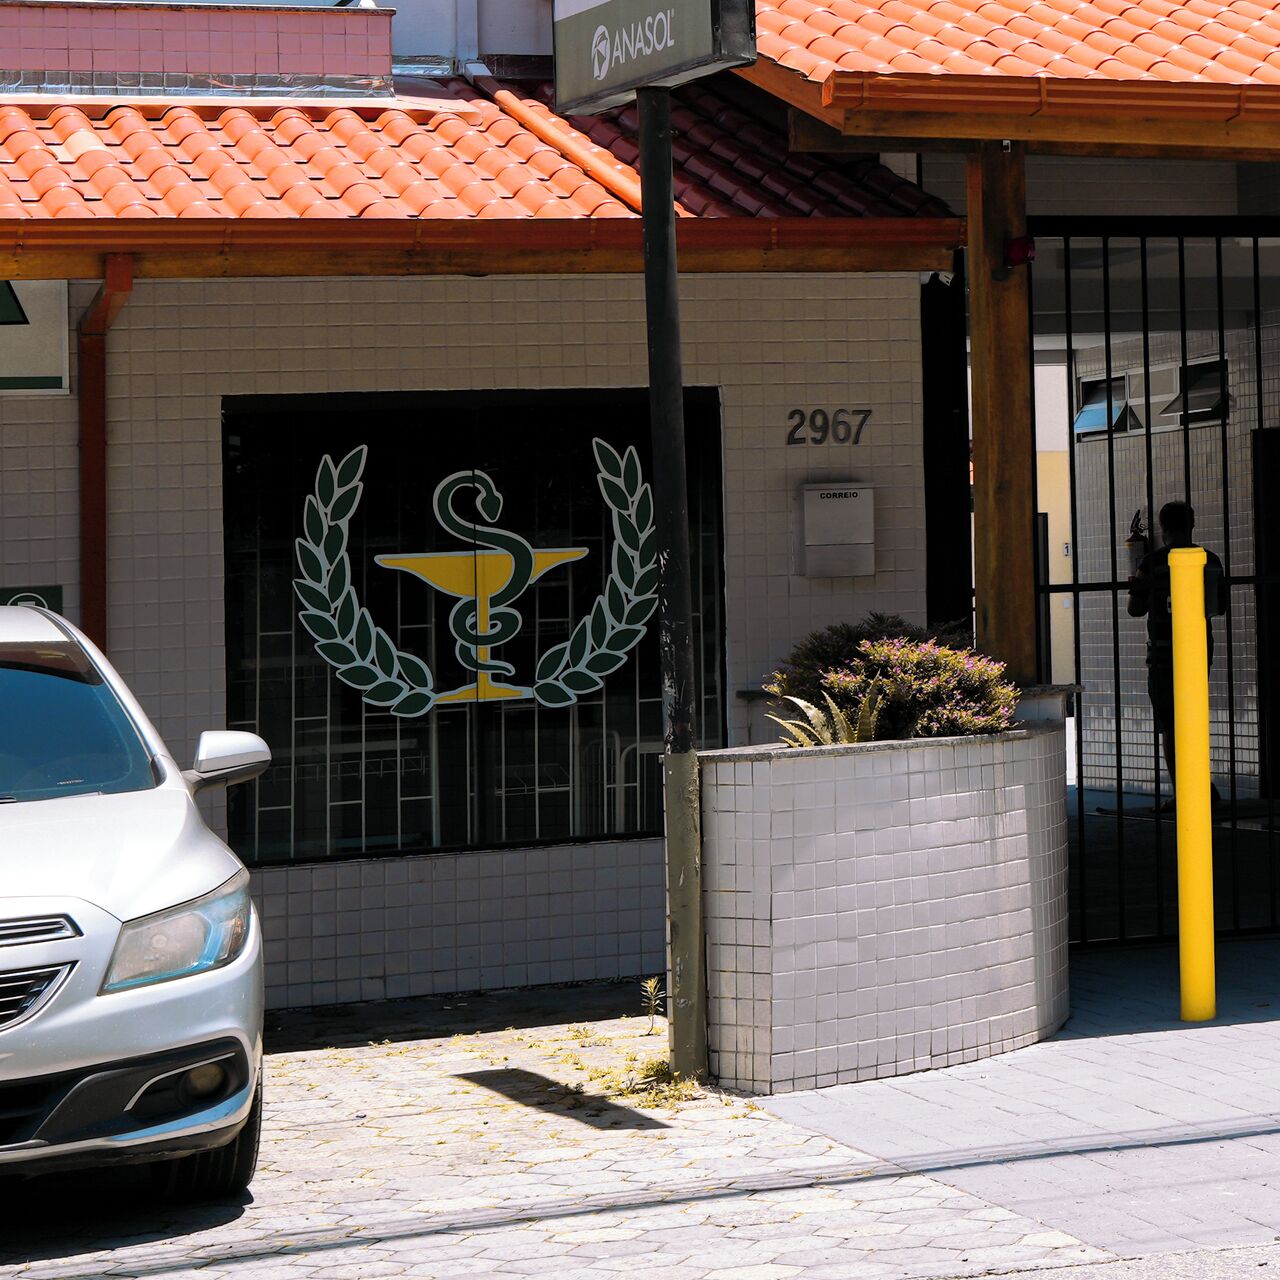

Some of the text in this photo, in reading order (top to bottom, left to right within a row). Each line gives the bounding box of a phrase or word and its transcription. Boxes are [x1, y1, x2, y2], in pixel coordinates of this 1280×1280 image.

[611, 9, 675, 68] ANASOL
[787, 408, 873, 446] 2967
[819, 491, 859, 500] CORREIO
